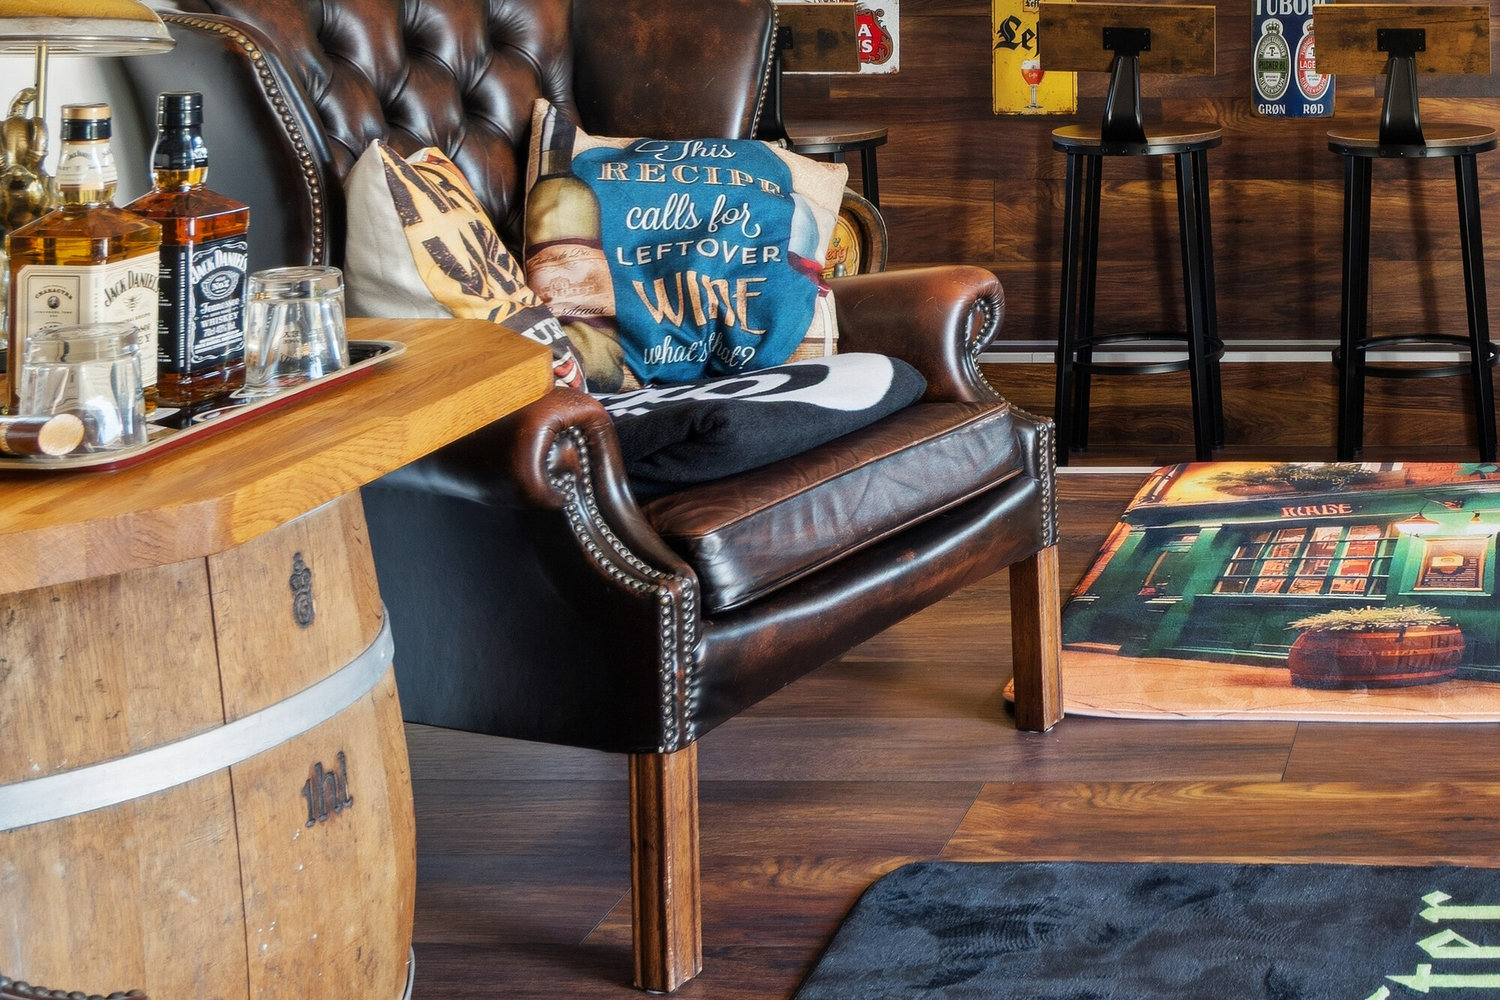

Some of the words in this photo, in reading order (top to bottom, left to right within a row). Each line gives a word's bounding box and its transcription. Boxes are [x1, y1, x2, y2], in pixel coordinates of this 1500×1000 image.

[1257, 103, 1286, 116] GRØN
[1302, 103, 1324, 116] RØD
[634, 138, 737, 162] This
[596, 161, 785, 200] RECIPE
[625, 193, 703, 232] calls
[708, 193, 762, 238] for
[616, 237, 783, 268] LEFTOVER
[192, 258, 215, 285] JACK
[104, 280, 127, 308] JACK
[631, 270, 768, 336] WINE
[199, 310, 240, 329] WHISKEY
[642, 335, 708, 366] what's
[707, 333, 757, 370] that?
